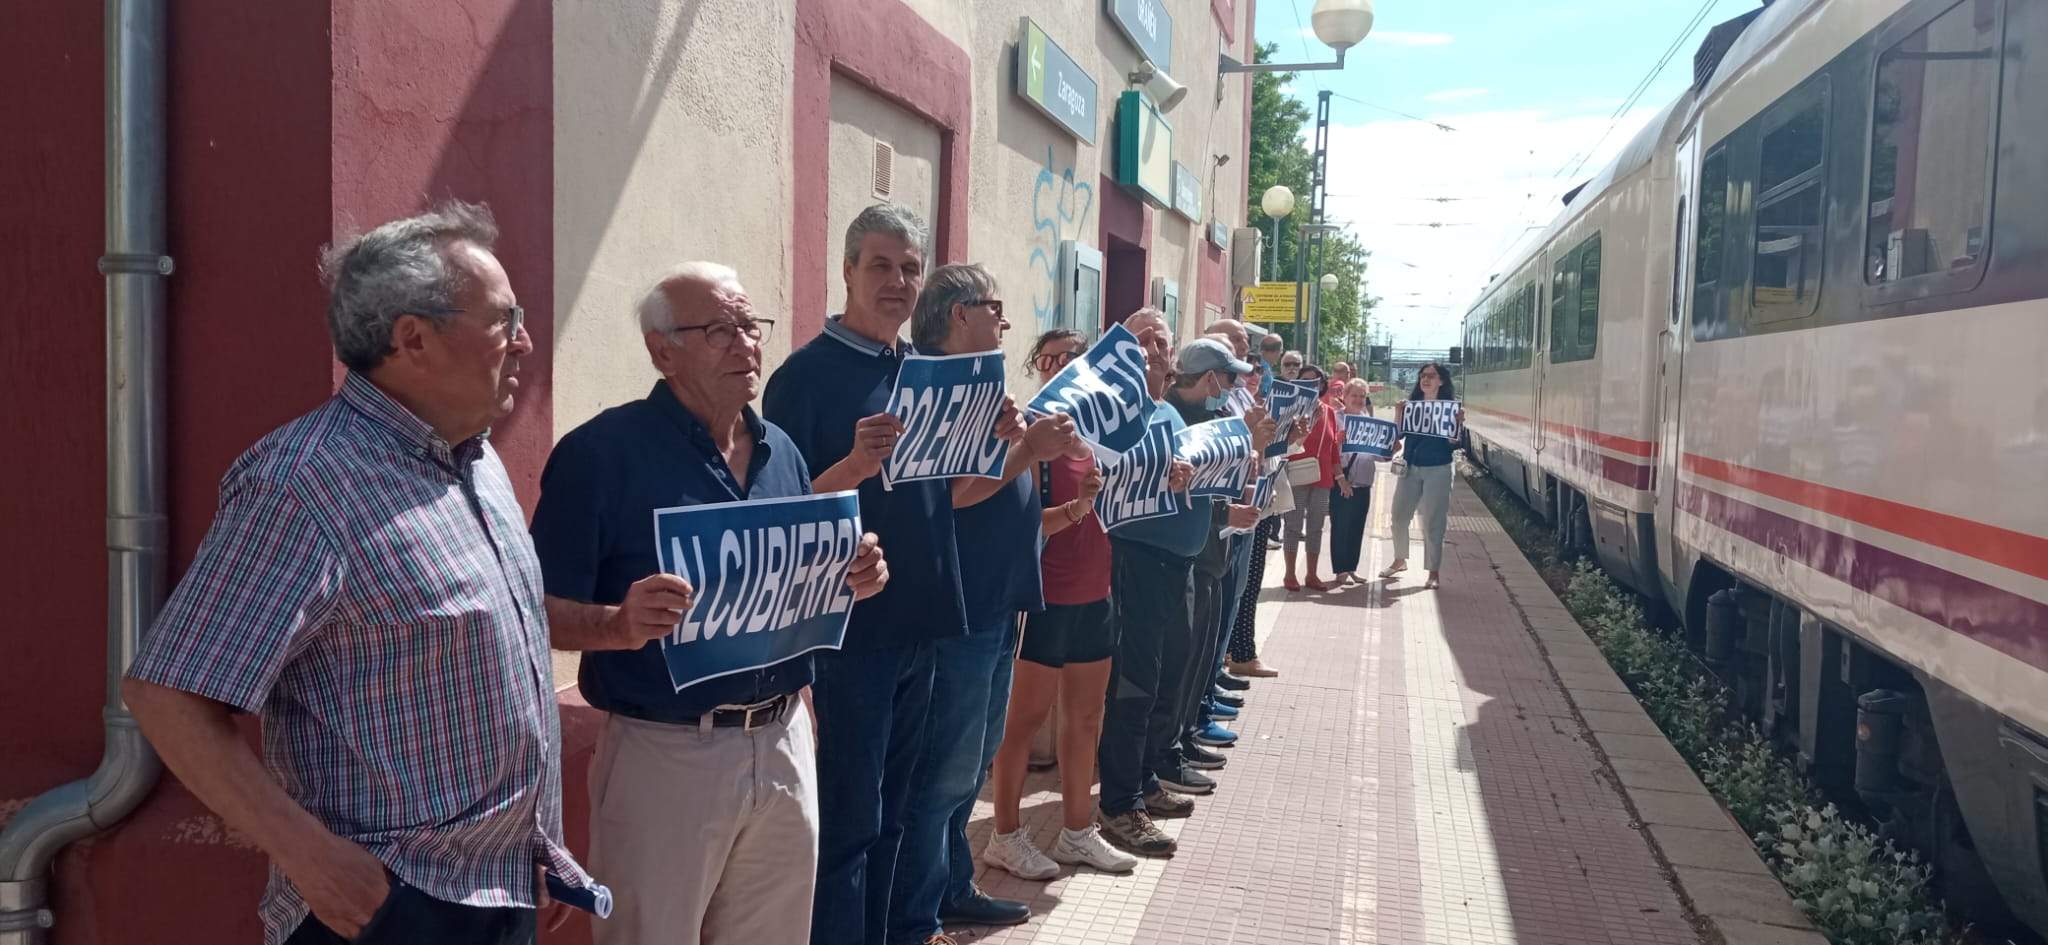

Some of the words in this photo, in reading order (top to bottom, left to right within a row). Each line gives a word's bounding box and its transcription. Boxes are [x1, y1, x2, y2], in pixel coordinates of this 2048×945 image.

[1058, 71, 1085, 117] Zaragoza
[1346, 420, 1396, 451] ALBERUELA
[1402, 402, 1458, 437] ROBRES
[1099, 425, 1173, 524] RAELLA
